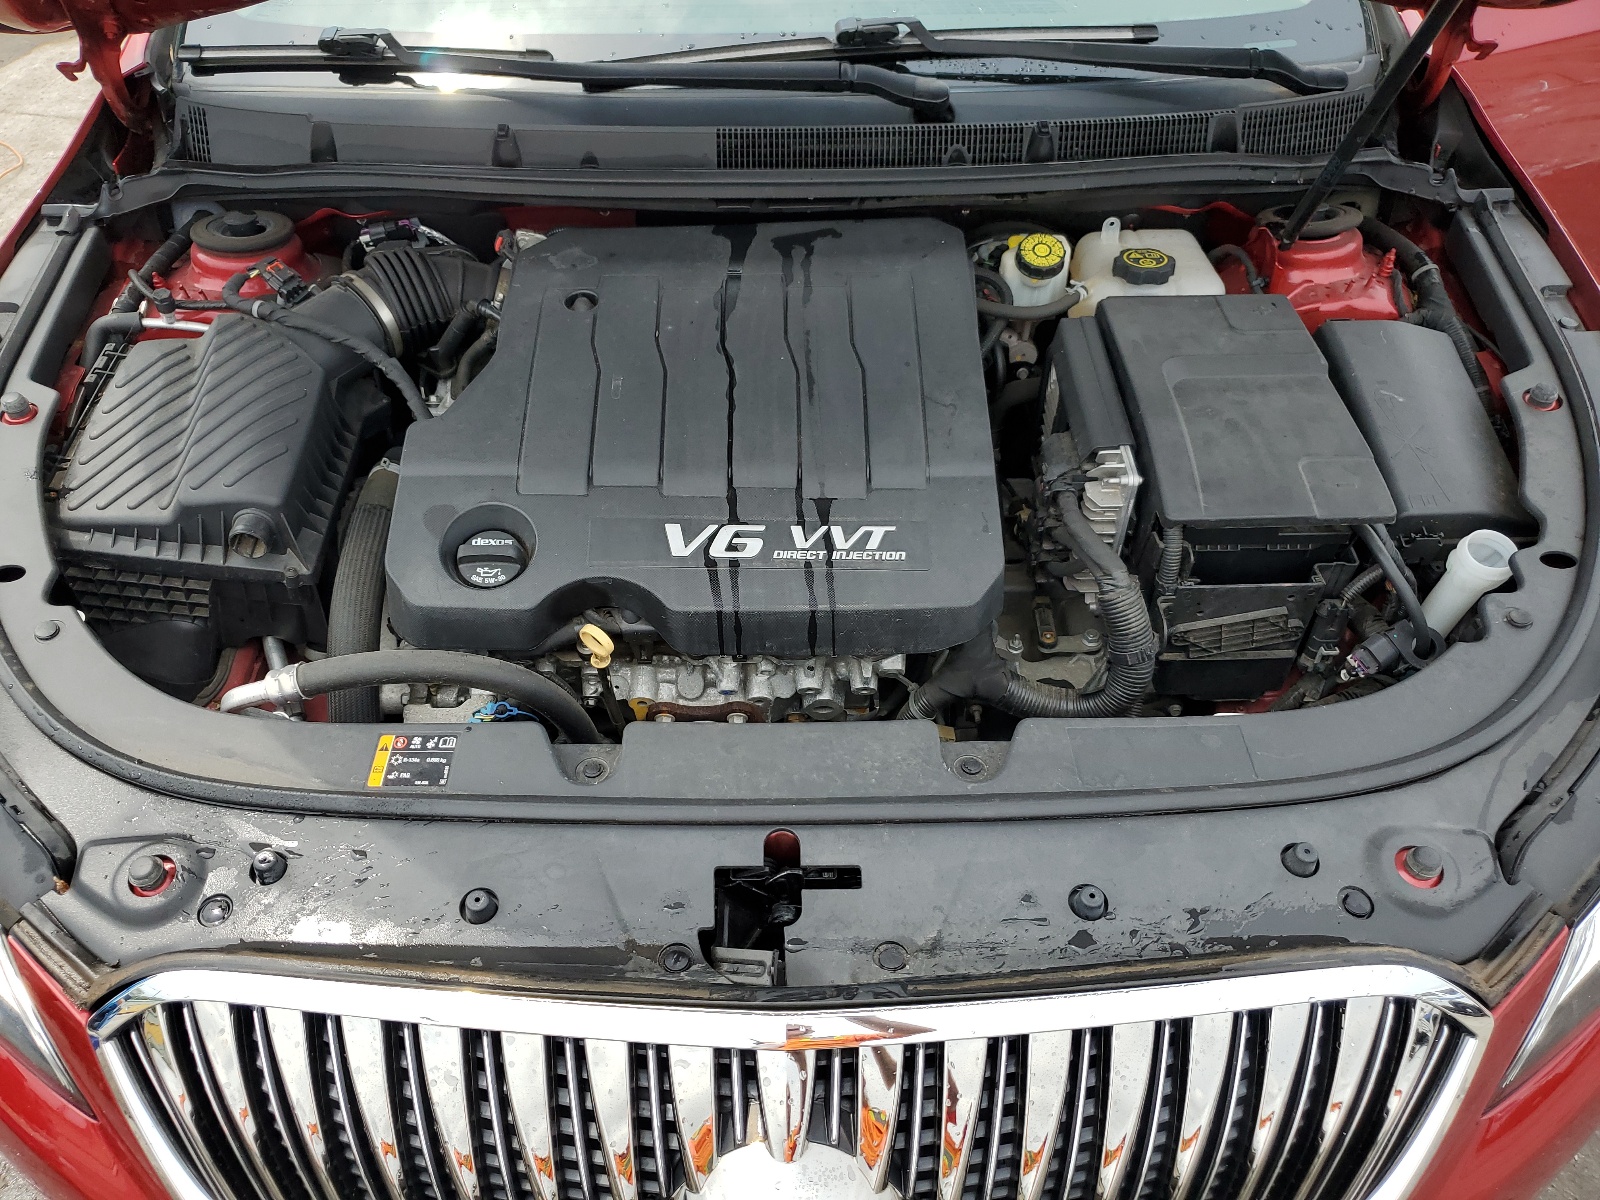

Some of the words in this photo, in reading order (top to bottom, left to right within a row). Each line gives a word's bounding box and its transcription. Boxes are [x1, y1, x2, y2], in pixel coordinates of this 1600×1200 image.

[471, 537, 514, 546] dexos
[664, 523, 766, 559] V6
[790, 525, 896, 550] VVT
[772, 550, 827, 560] DIRECT
[831, 550, 906, 561] INJECTION
